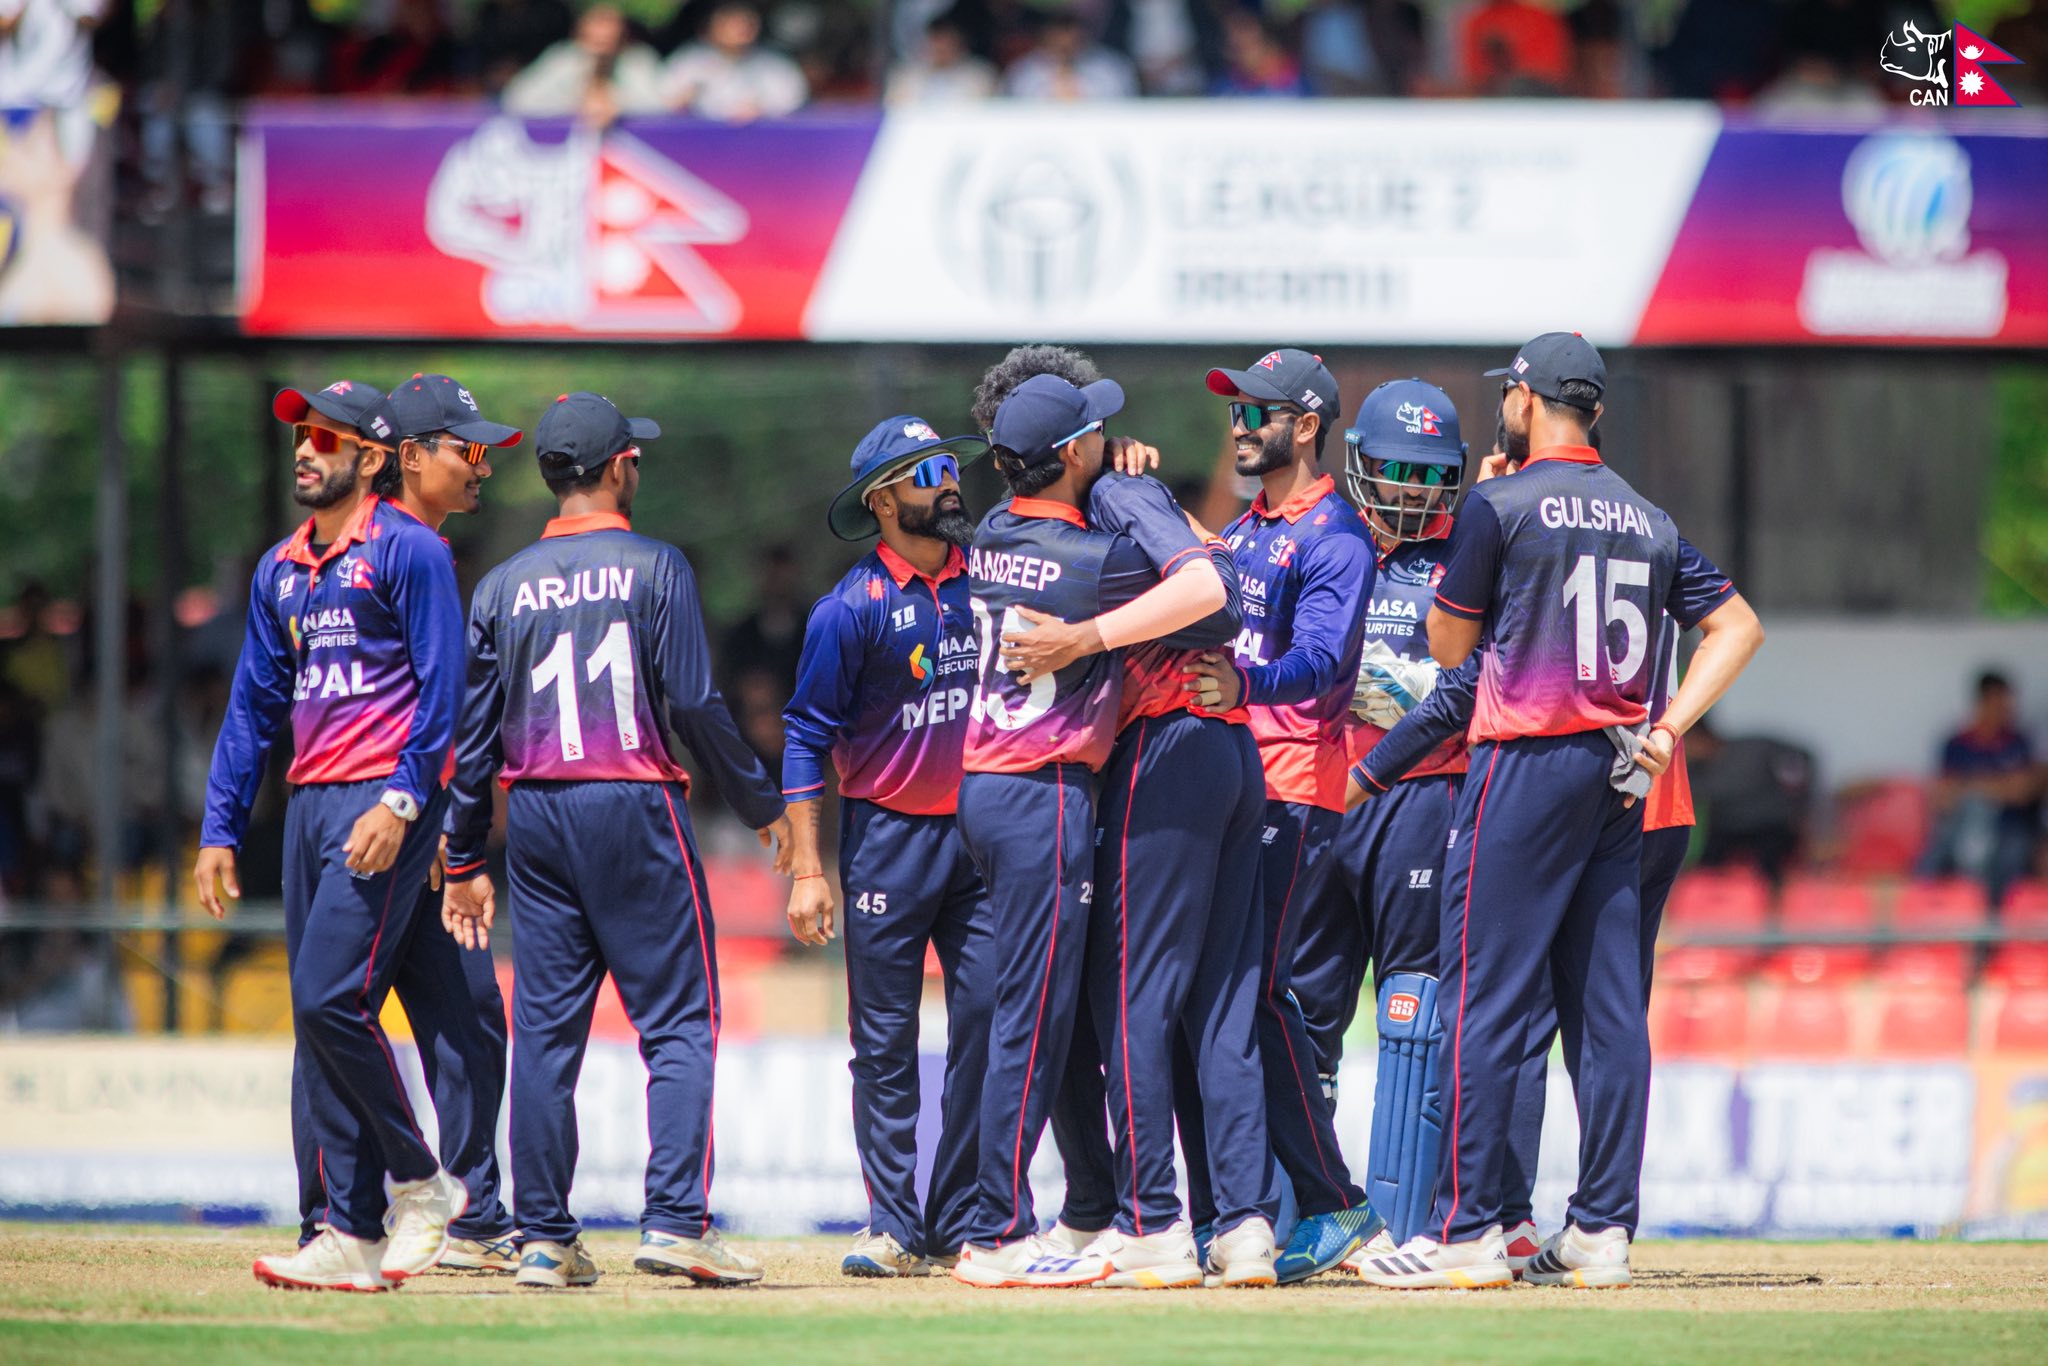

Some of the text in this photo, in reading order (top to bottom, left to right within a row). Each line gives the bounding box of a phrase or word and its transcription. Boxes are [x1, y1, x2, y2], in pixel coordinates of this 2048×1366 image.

[1540, 497, 1653, 539] GULSHAN
[512, 567, 633, 616] ARJUN
[1367, 598, 1418, 619] AASA
[1563, 555, 1650, 685] 15
[938, 634, 978, 657] NAA
[293, 660, 376, 702] EPAL
[937, 658, 979, 676] SECURI
[531, 621, 640, 762] 11
[902, 684, 981, 731] NEP
[855, 892, 887, 915] 45
[1390, 999, 1415, 1017] SS
